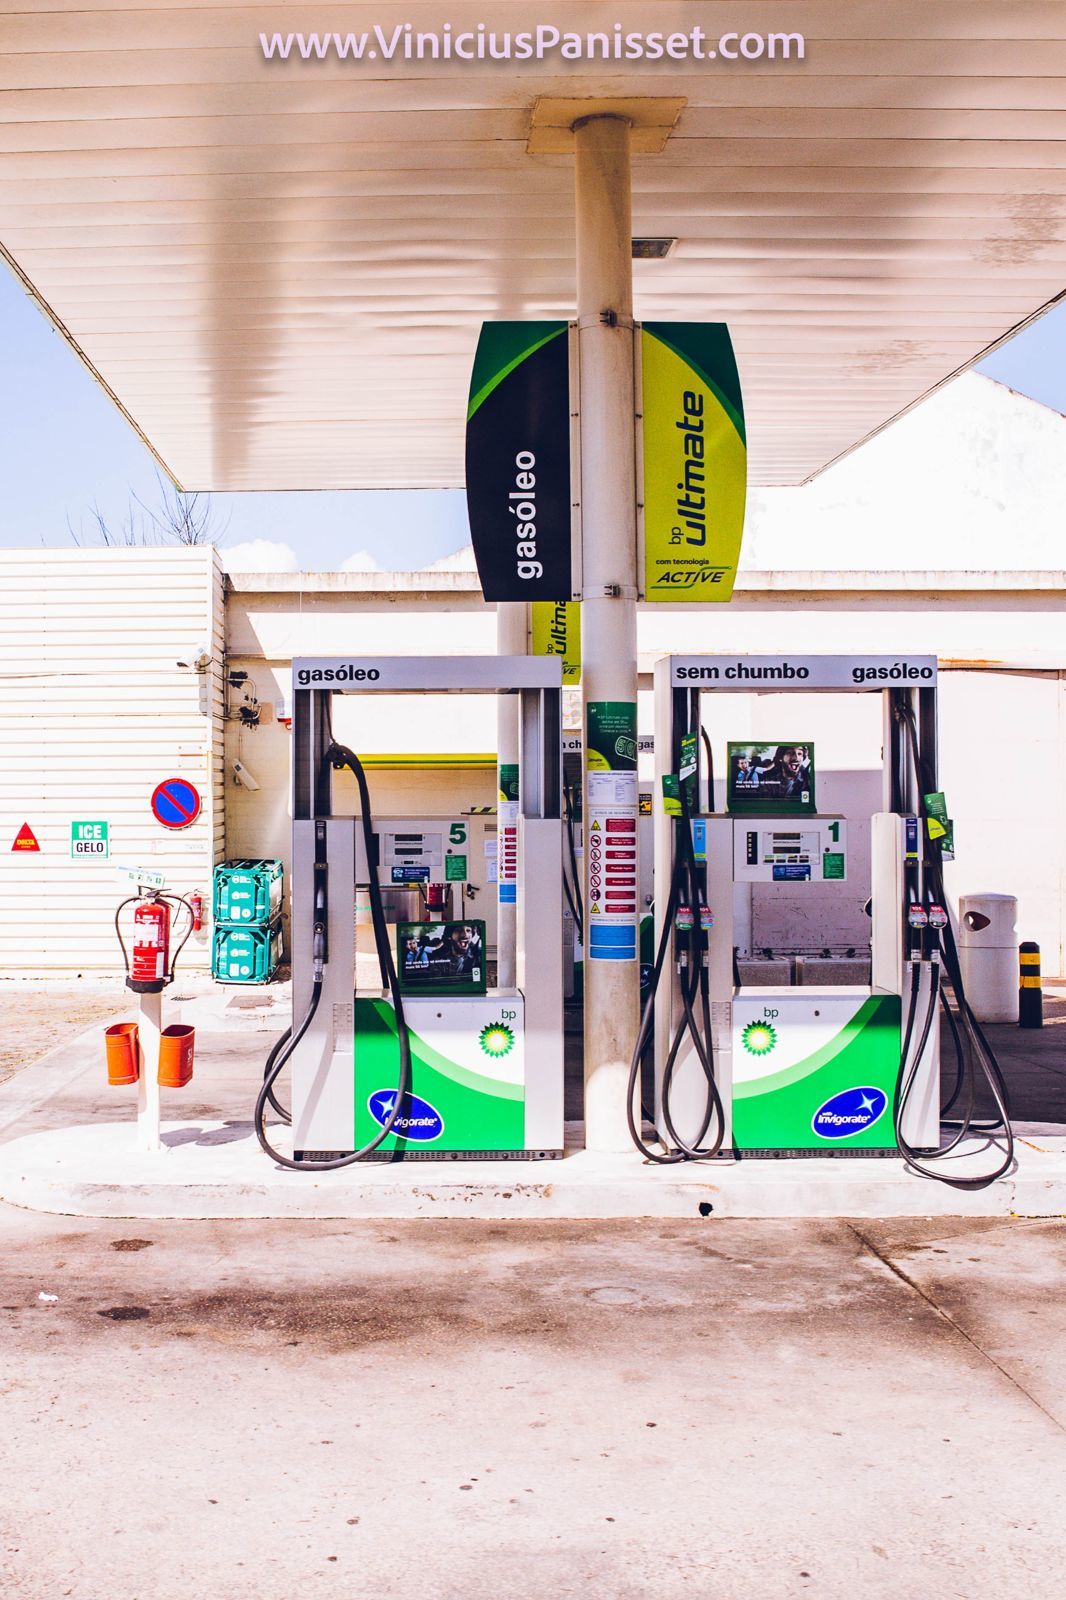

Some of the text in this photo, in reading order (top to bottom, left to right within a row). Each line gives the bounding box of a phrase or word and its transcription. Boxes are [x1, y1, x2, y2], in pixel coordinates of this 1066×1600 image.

[676, 390, 706, 547] ultimate
[508, 450, 543, 580] gasóleo
[668, 526, 684, 545] bp
[673, 557, 710, 567] tecnologia
[656, 571, 725, 583] ACTIVE
[297, 664, 381, 685] gasóleo
[675, 662, 810, 680] sem chumbo
[851, 662, 934, 684] gasóleo
[78, 824, 102, 839] ICE
[449, 823, 466, 844] 5
[828, 821, 839, 842] 1
[76, 842, 104, 853] GELO
[501, 1008, 517, 1021] bp
[763, 1007, 779, 1020] bp
